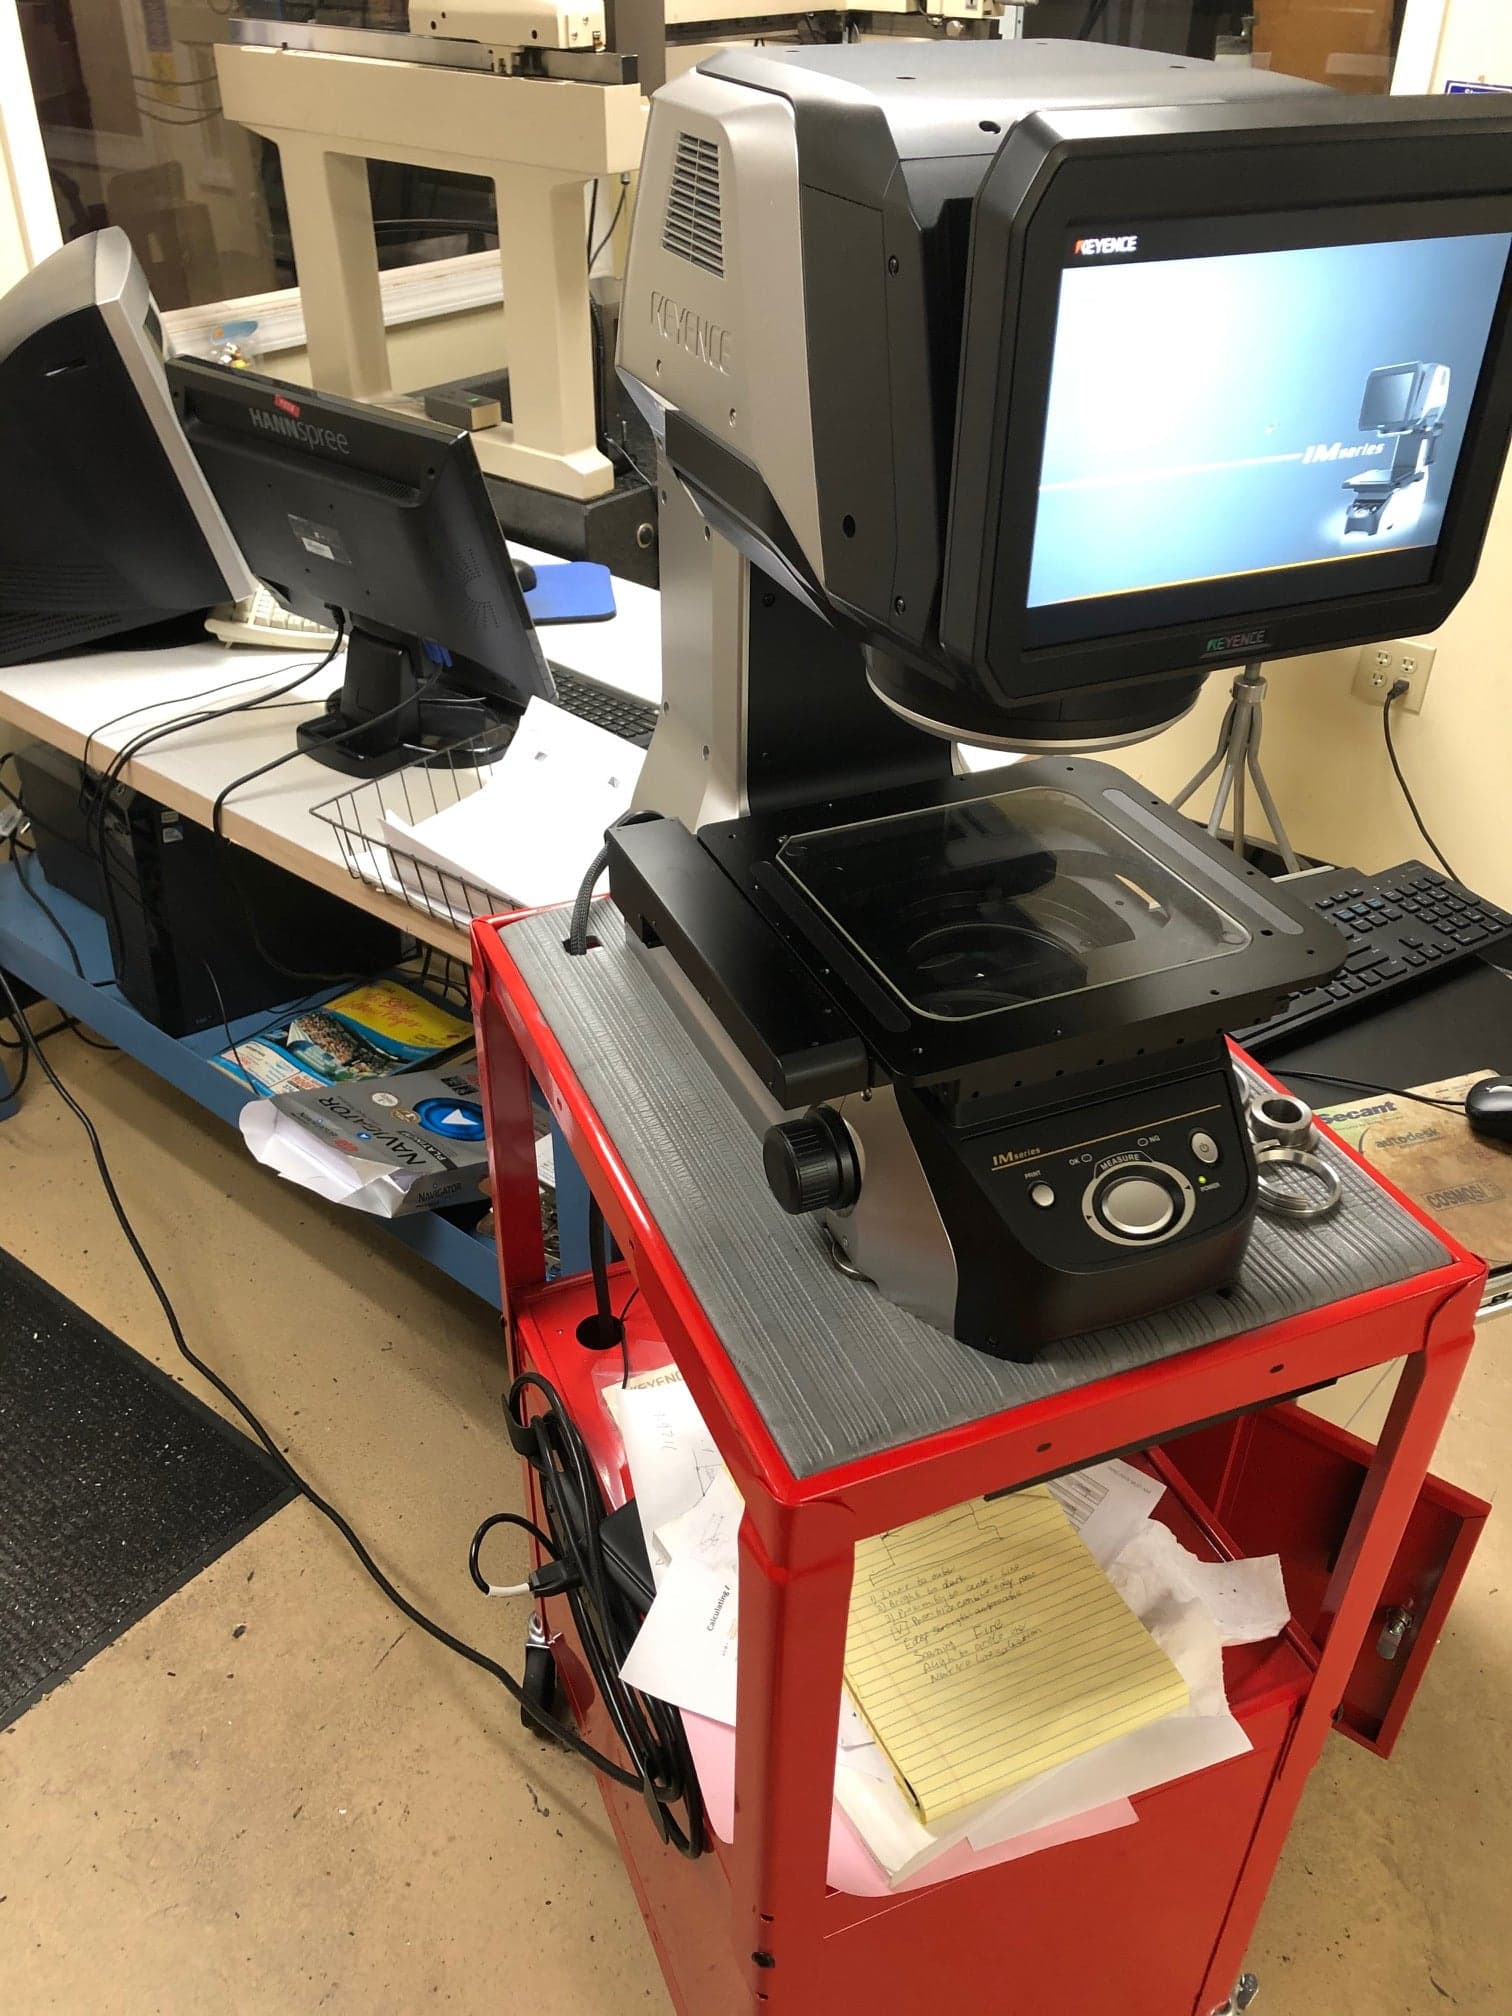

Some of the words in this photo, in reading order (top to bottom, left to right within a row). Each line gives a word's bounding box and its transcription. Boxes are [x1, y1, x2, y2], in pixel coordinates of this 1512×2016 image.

[1073, 236, 1138, 255] KEYENCE
[650, 290, 732, 377] KEYENCE
[1206, 629, 1266, 651] KEYENCE
[1318, 1101, 1398, 1125] Secant
[319, 1096, 427, 1166] NAVIGATOR
[1100, 1152, 1141, 1171] MEASURE
[707, 1591, 730, 1632] Calculating
